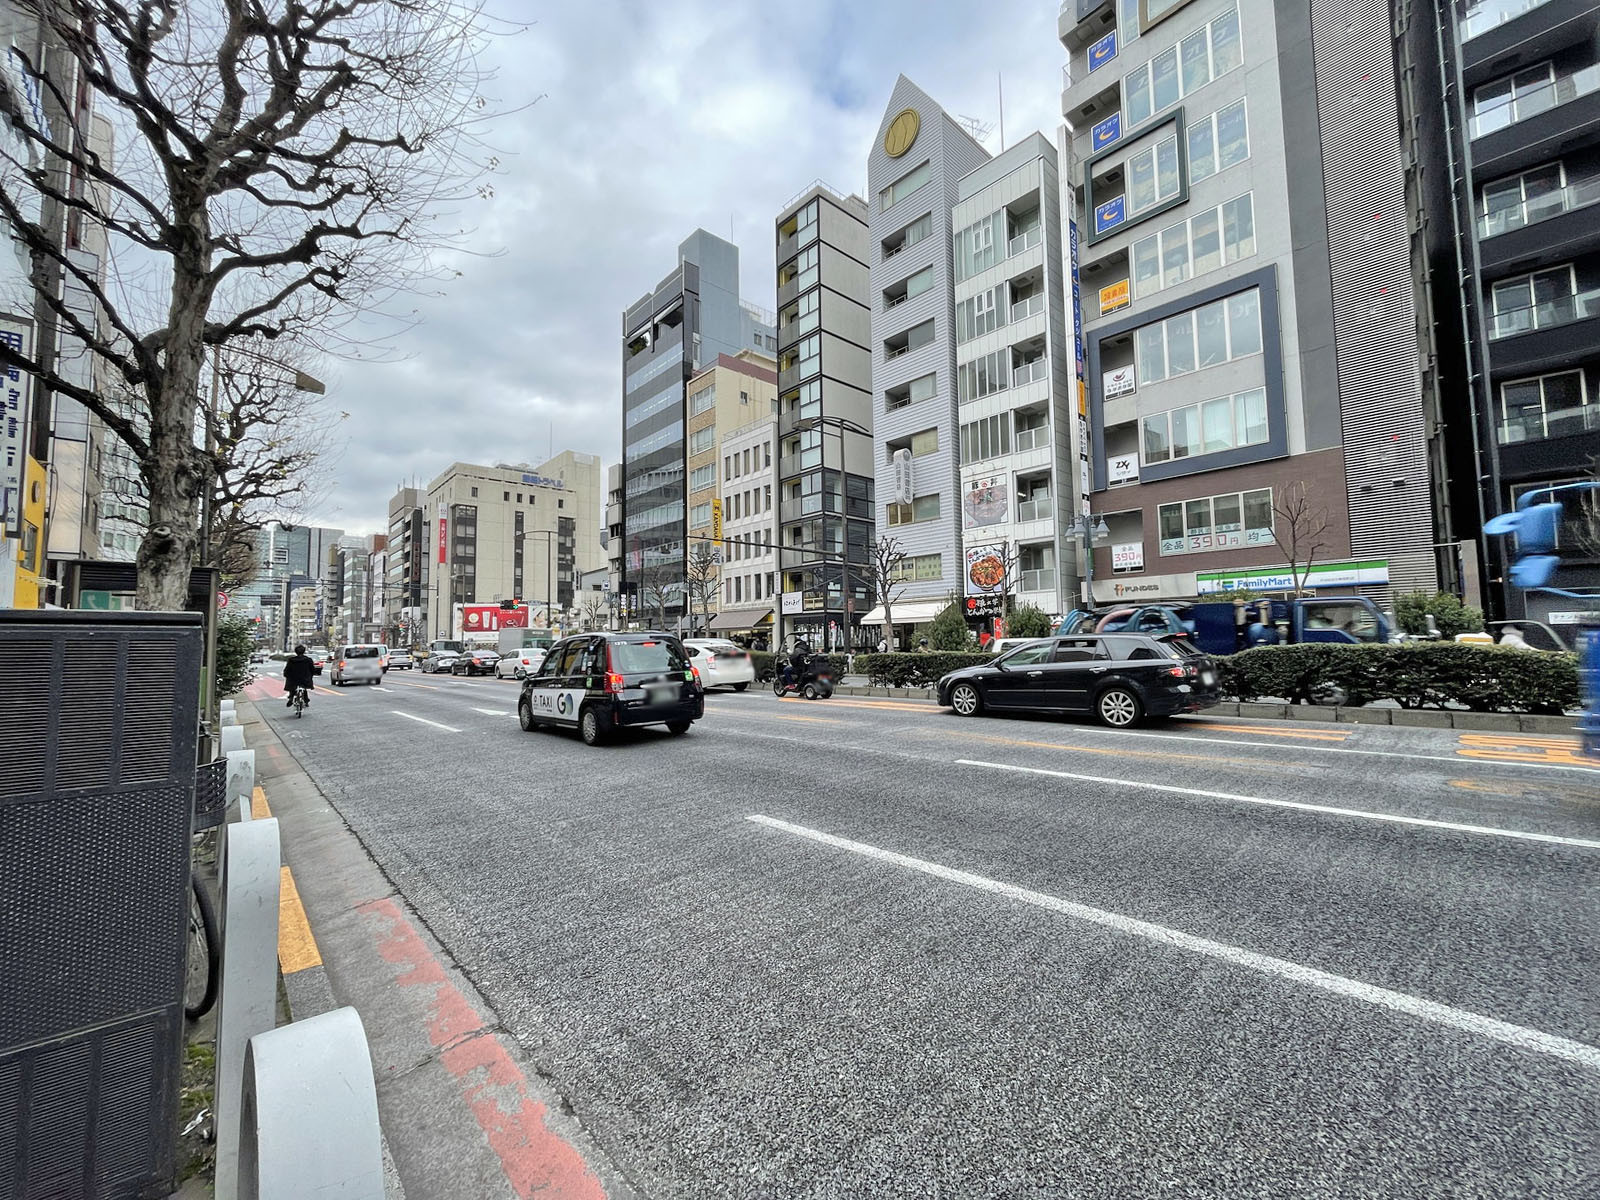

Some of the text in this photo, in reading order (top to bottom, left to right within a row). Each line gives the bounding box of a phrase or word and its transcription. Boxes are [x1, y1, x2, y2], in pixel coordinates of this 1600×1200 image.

[1095, 117, 1118, 135] カラオケ
[1098, 199, 1122, 215] カラオケ
[1116, 460, 1130, 470] ZXY
[1237, 577, 1292, 588] FamilyMart
[539, 695, 552, 708] TAXI
[557, 692, 574, 715] GO
